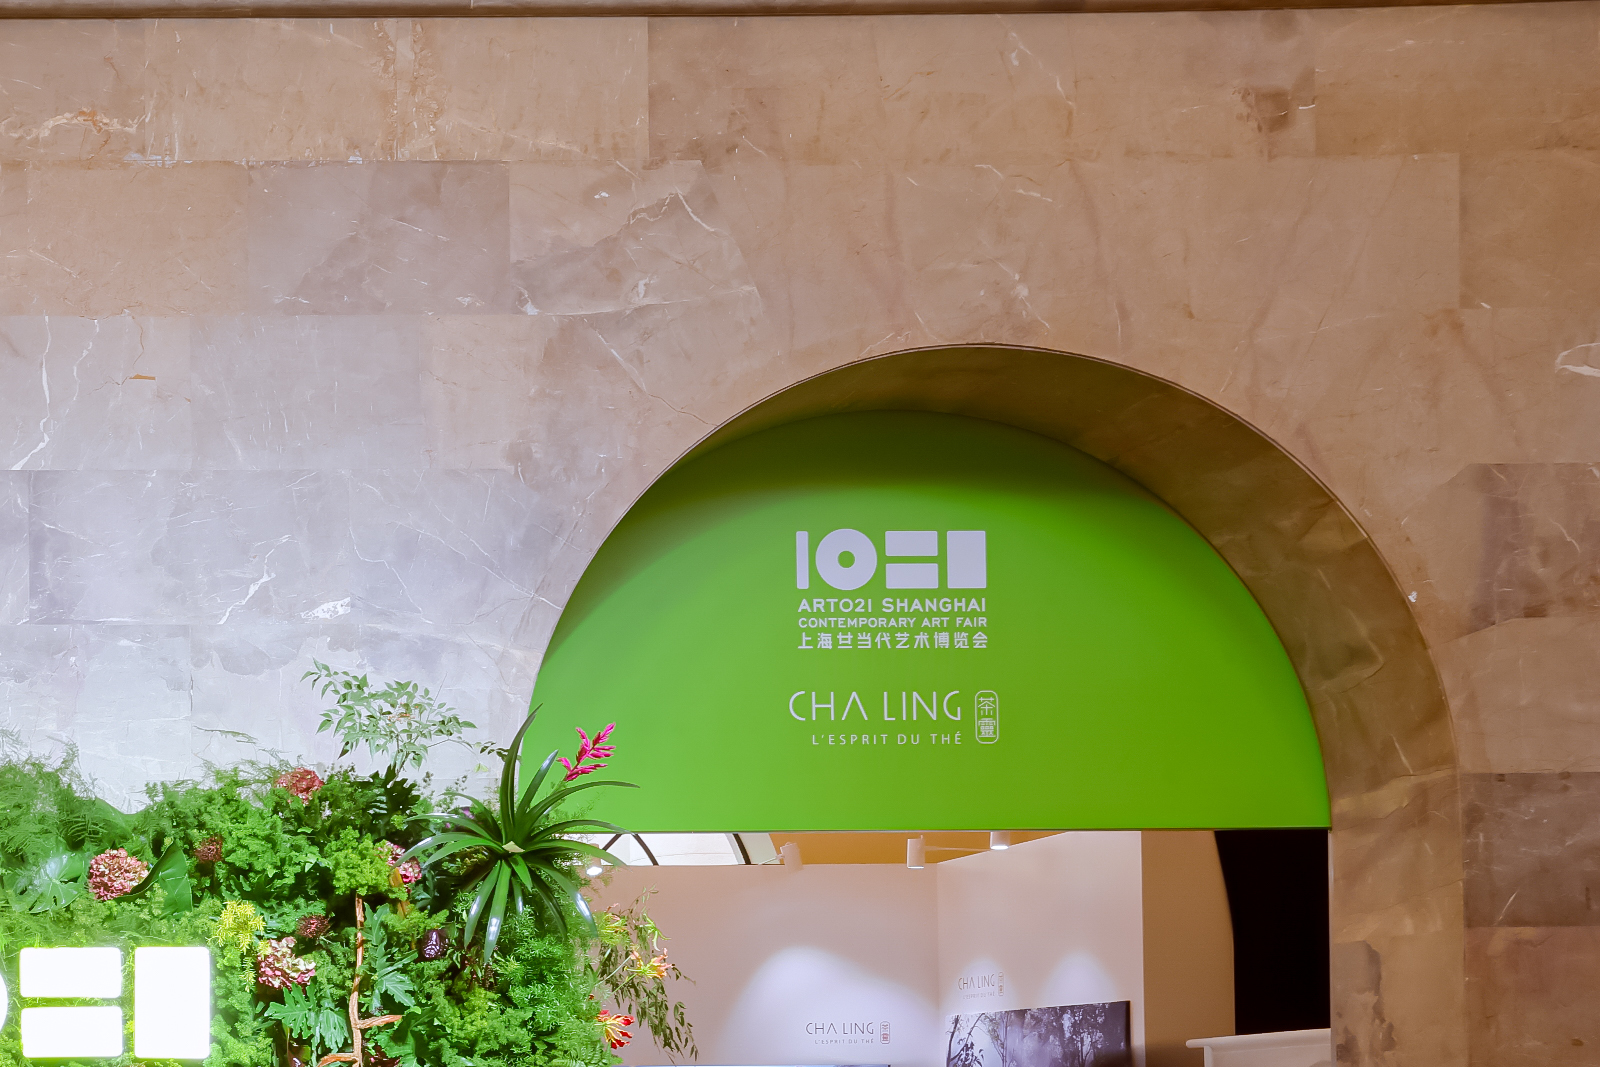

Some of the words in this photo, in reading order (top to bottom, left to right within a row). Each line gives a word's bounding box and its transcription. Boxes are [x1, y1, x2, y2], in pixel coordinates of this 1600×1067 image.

[882, 598, 985, 612] SHANGHAI
[799, 618, 916, 628] CONTEMPORARY
[921, 618, 949, 627] ART
[957, 617, 986, 627] FAIR
[789, 691, 867, 720] CHA
[884, 691, 960, 720] LING
[898, 734, 919, 744] DU
[930, 731, 961, 744] THÉ
[805, 1022, 838, 1035] CHA
[842, 1022, 874, 1035] LING
